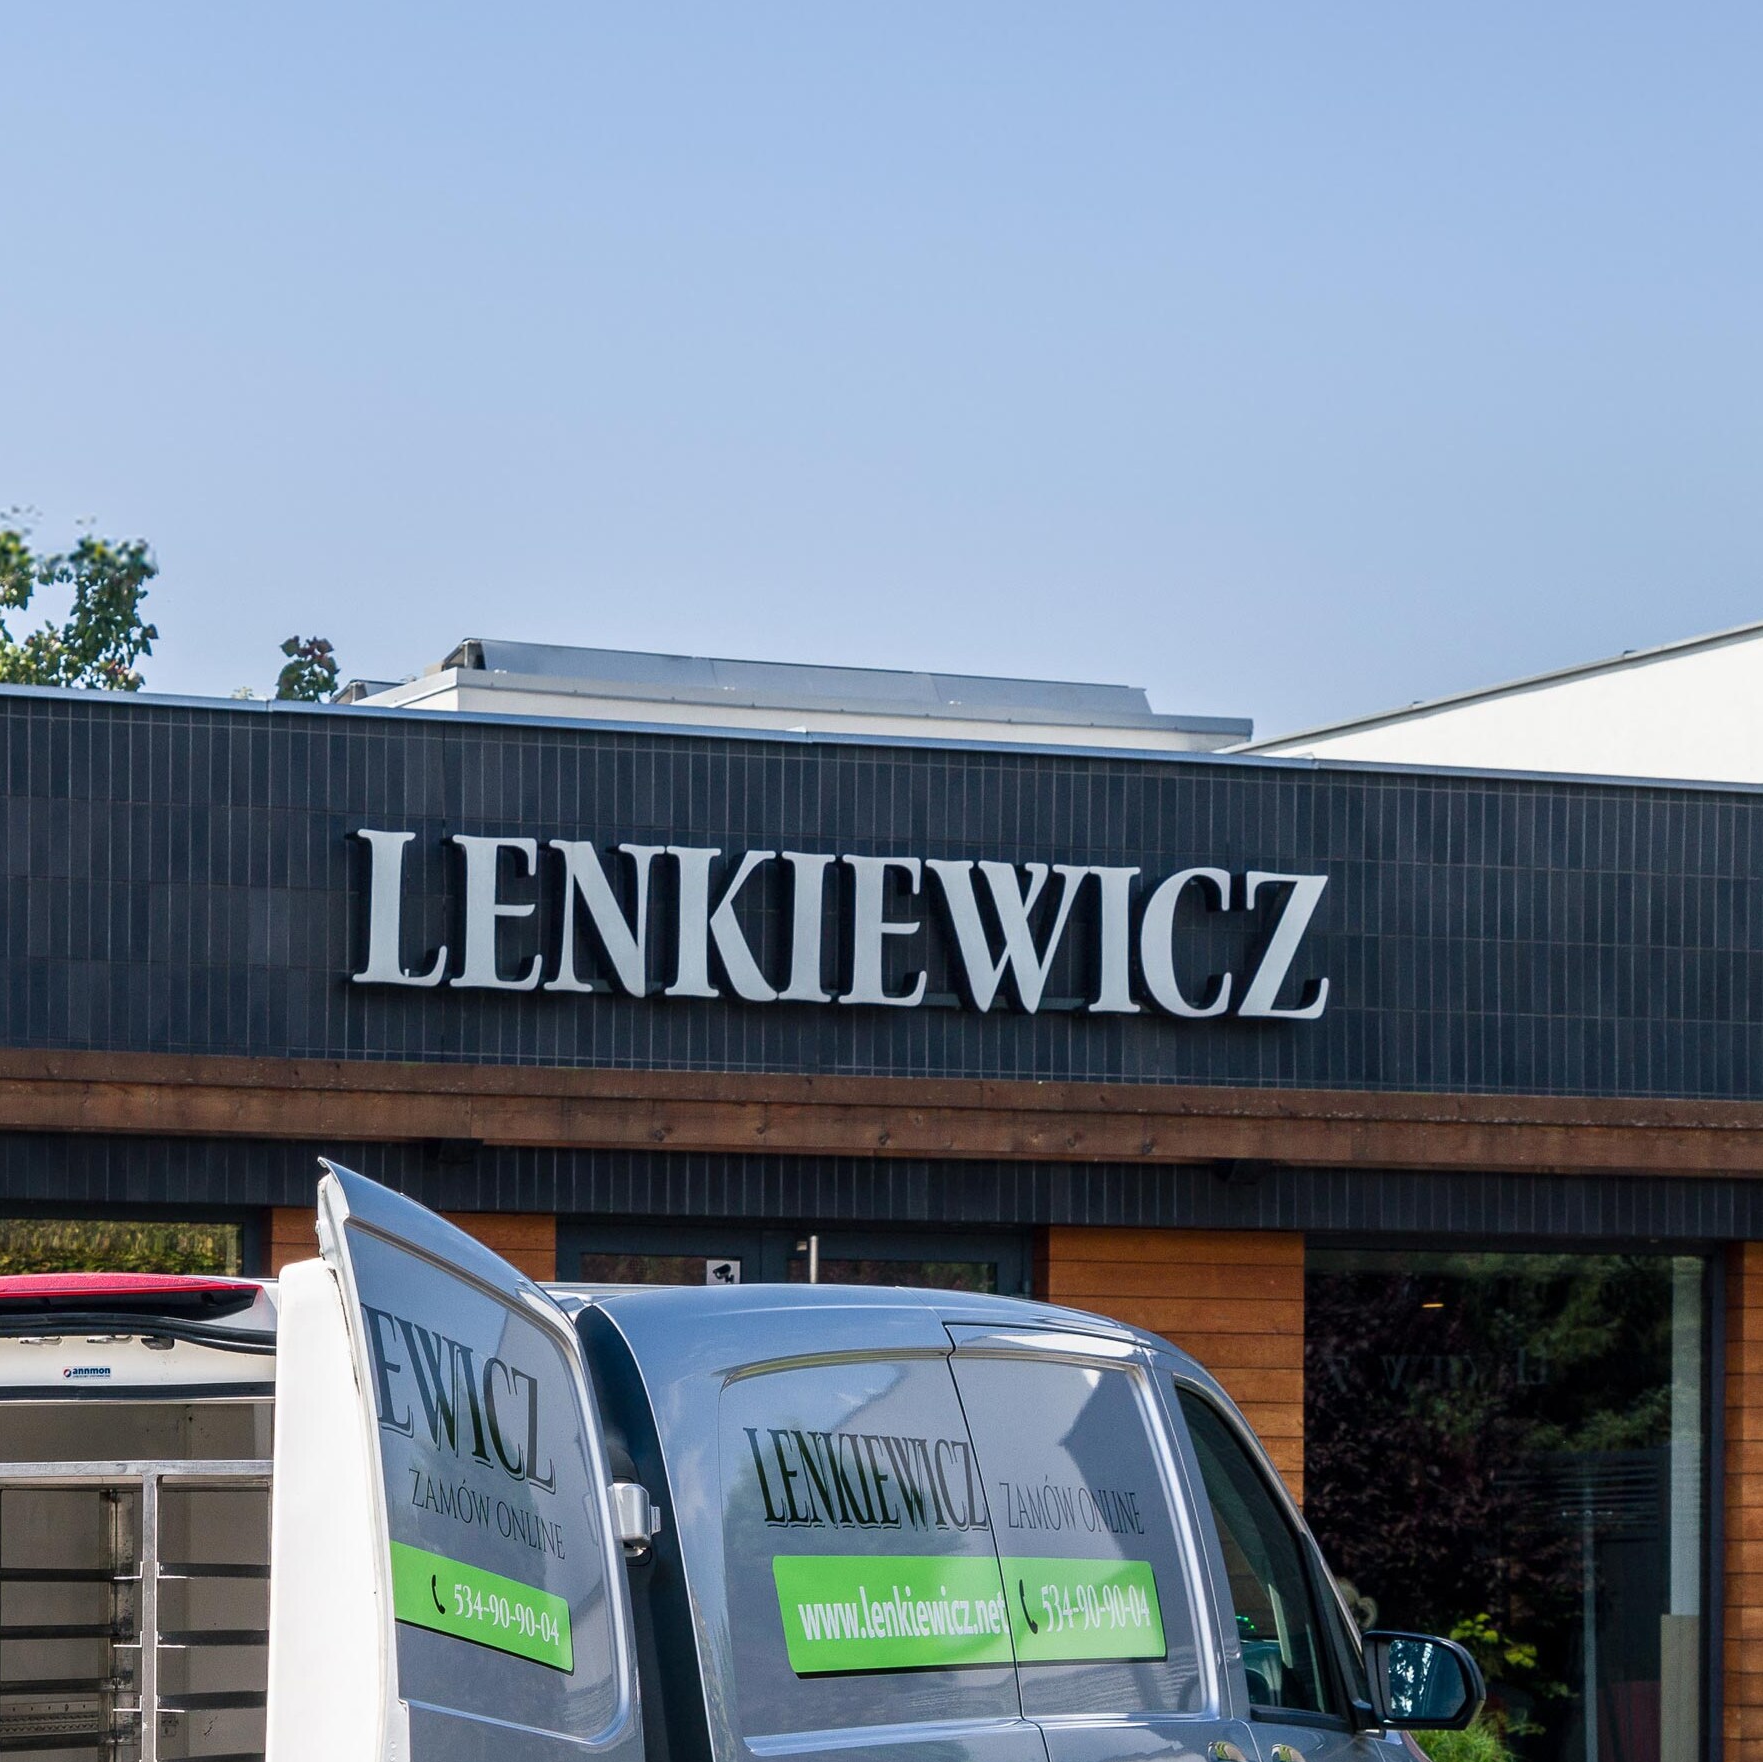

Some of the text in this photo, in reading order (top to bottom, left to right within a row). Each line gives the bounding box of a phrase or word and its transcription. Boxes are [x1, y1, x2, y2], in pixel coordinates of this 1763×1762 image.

[351, 828, 1330, 1019] LENKIEWICZ
[72, 1367, 111, 1375] annmon
[360, 1302, 556, 1495] EWICZ
[743, 1427, 989, 1532] LENKIEWICZ
[999, 1474, 1145, 1535] ZAMÓW ONLINE
[408, 1468, 566, 1561] ZAMÓW ONLINE
[453, 1583, 560, 1646] 534-90-90-04
[797, 1586, 1009, 1641] www.lenkiewicz.net
[1041, 1584, 1151, 1633] 534-90-90-04
